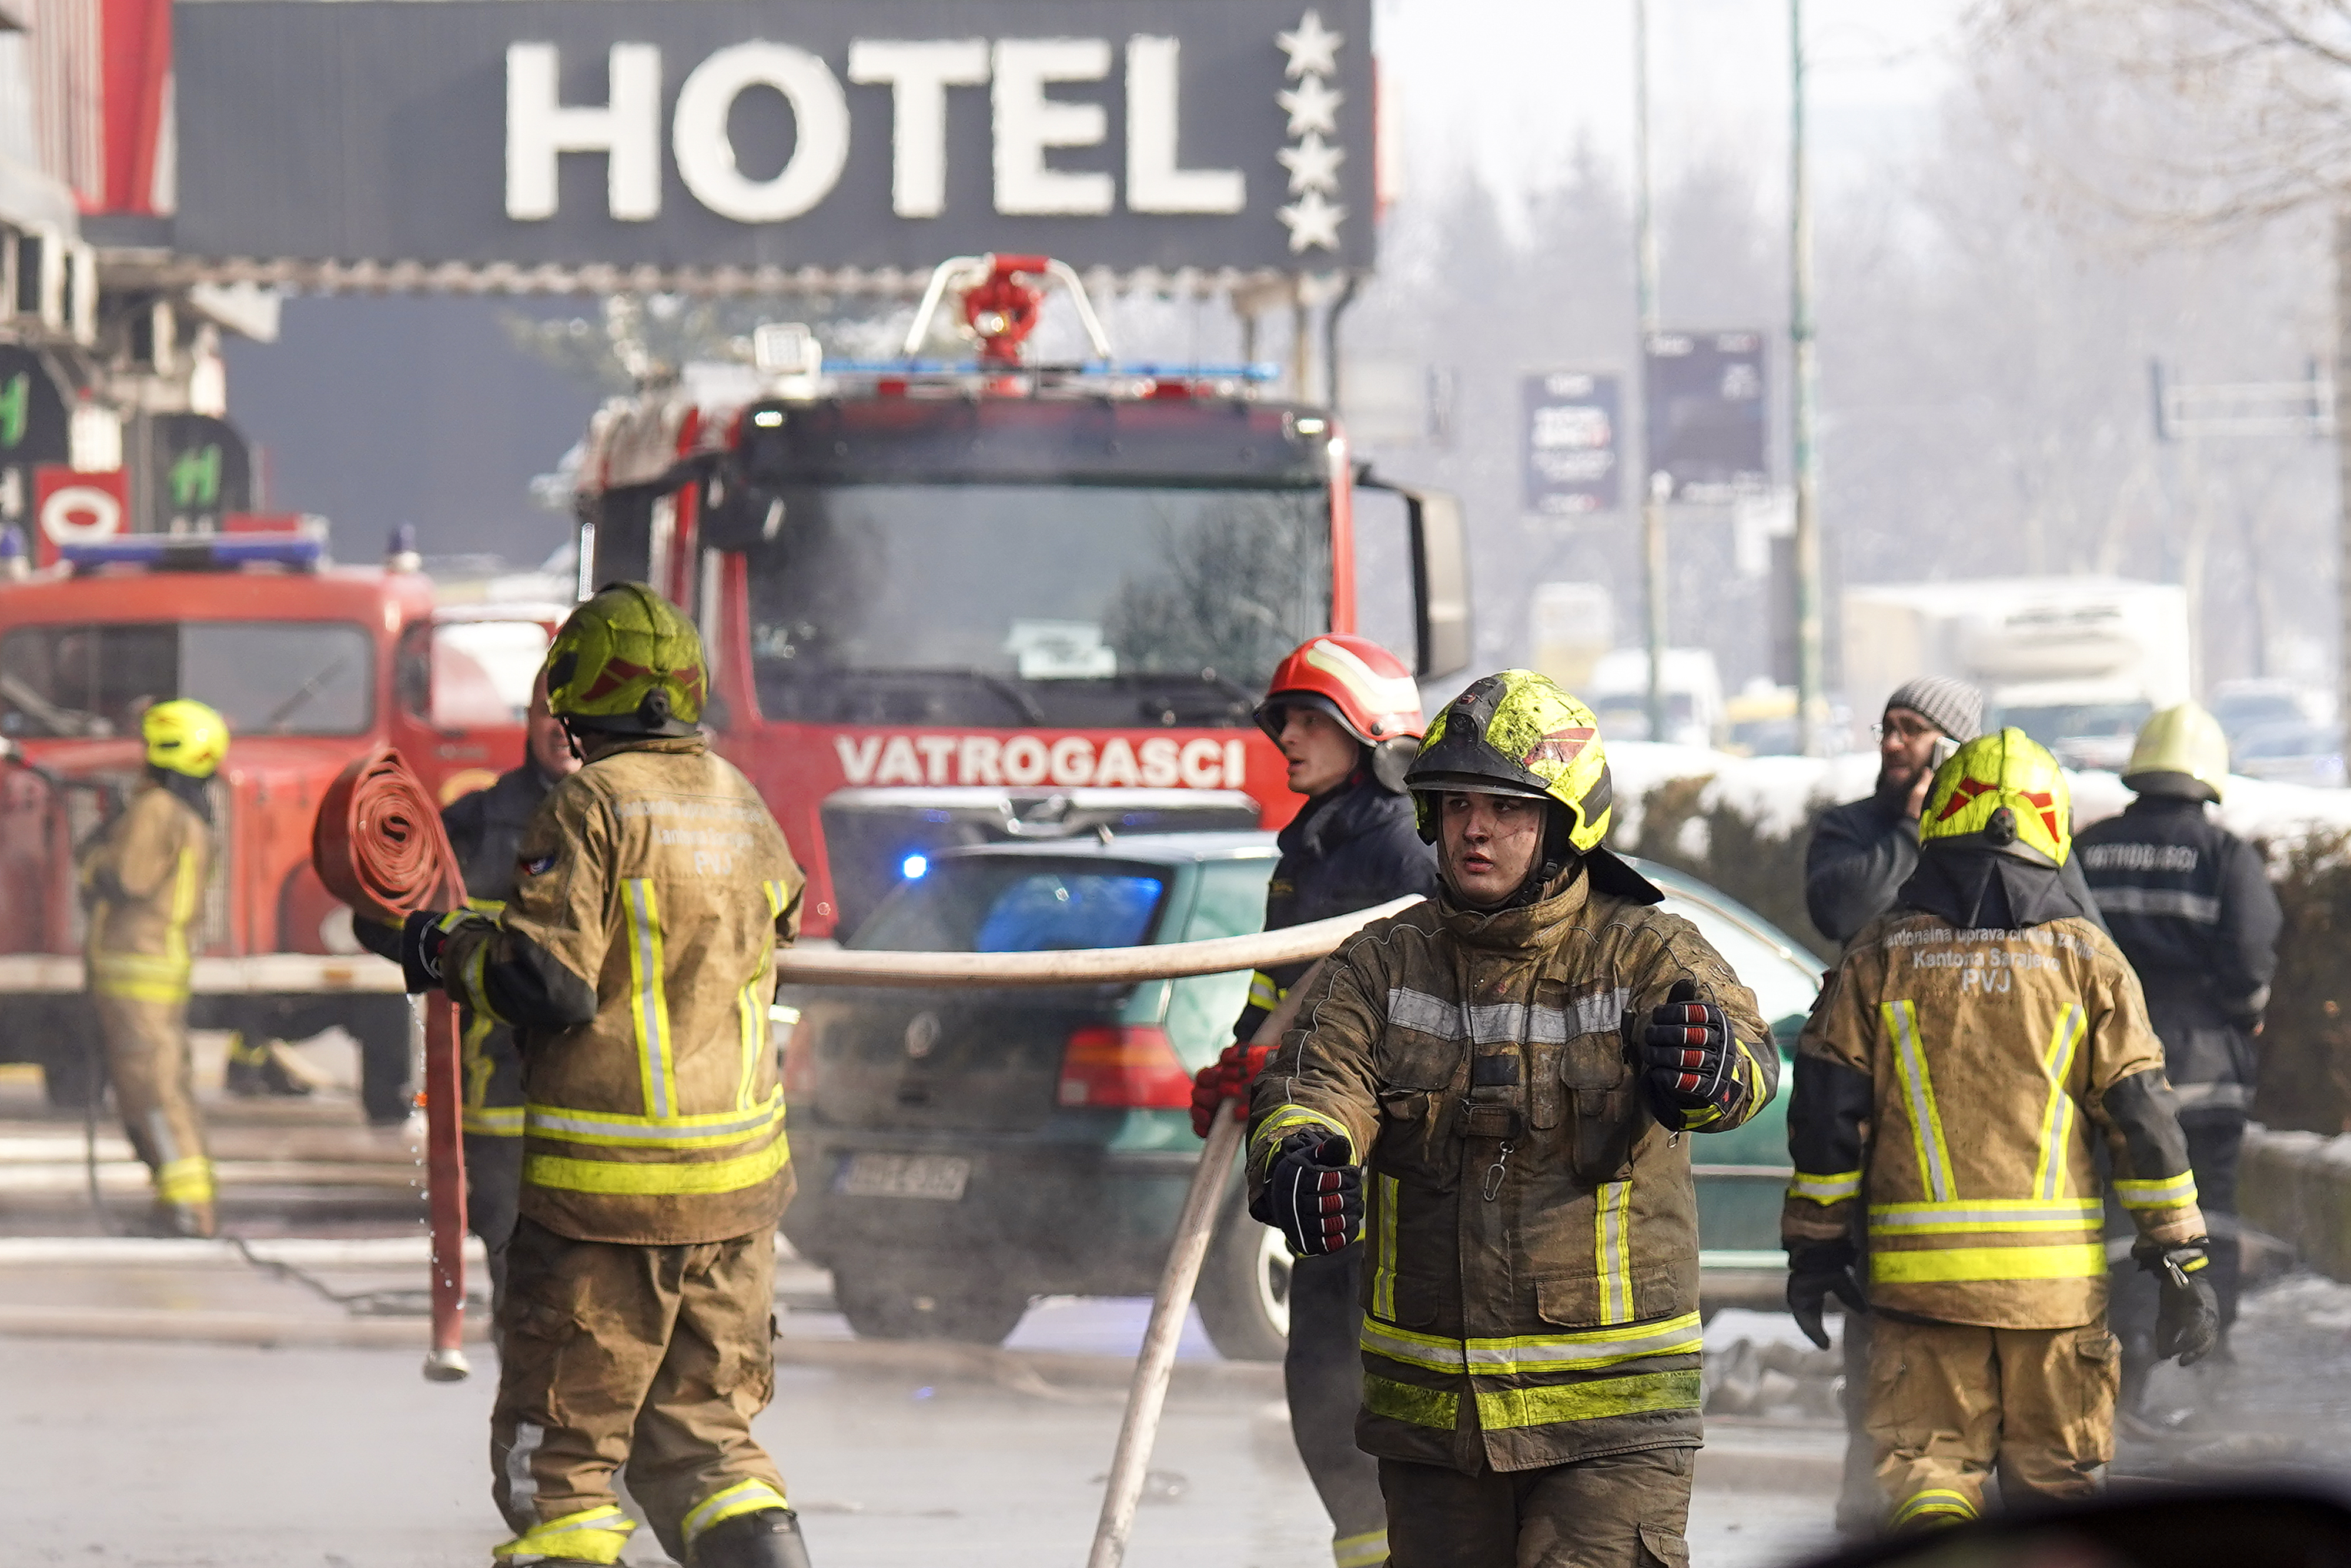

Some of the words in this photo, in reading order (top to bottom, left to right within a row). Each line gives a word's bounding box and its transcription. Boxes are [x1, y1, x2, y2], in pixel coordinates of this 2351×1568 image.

[505, 35, 1247, 223] HOTEL
[834, 734, 1247, 788] VATROGASCI
[694, 850, 732, 875] PVJ
[1884, 926, 1954, 948] antonalna
[1955, 927, 2005, 947] uprava
[1913, 950, 1985, 969] Kantona
[1989, 947, 2061, 972] Sarajevo
[1961, 968, 2012, 993] PVJ
